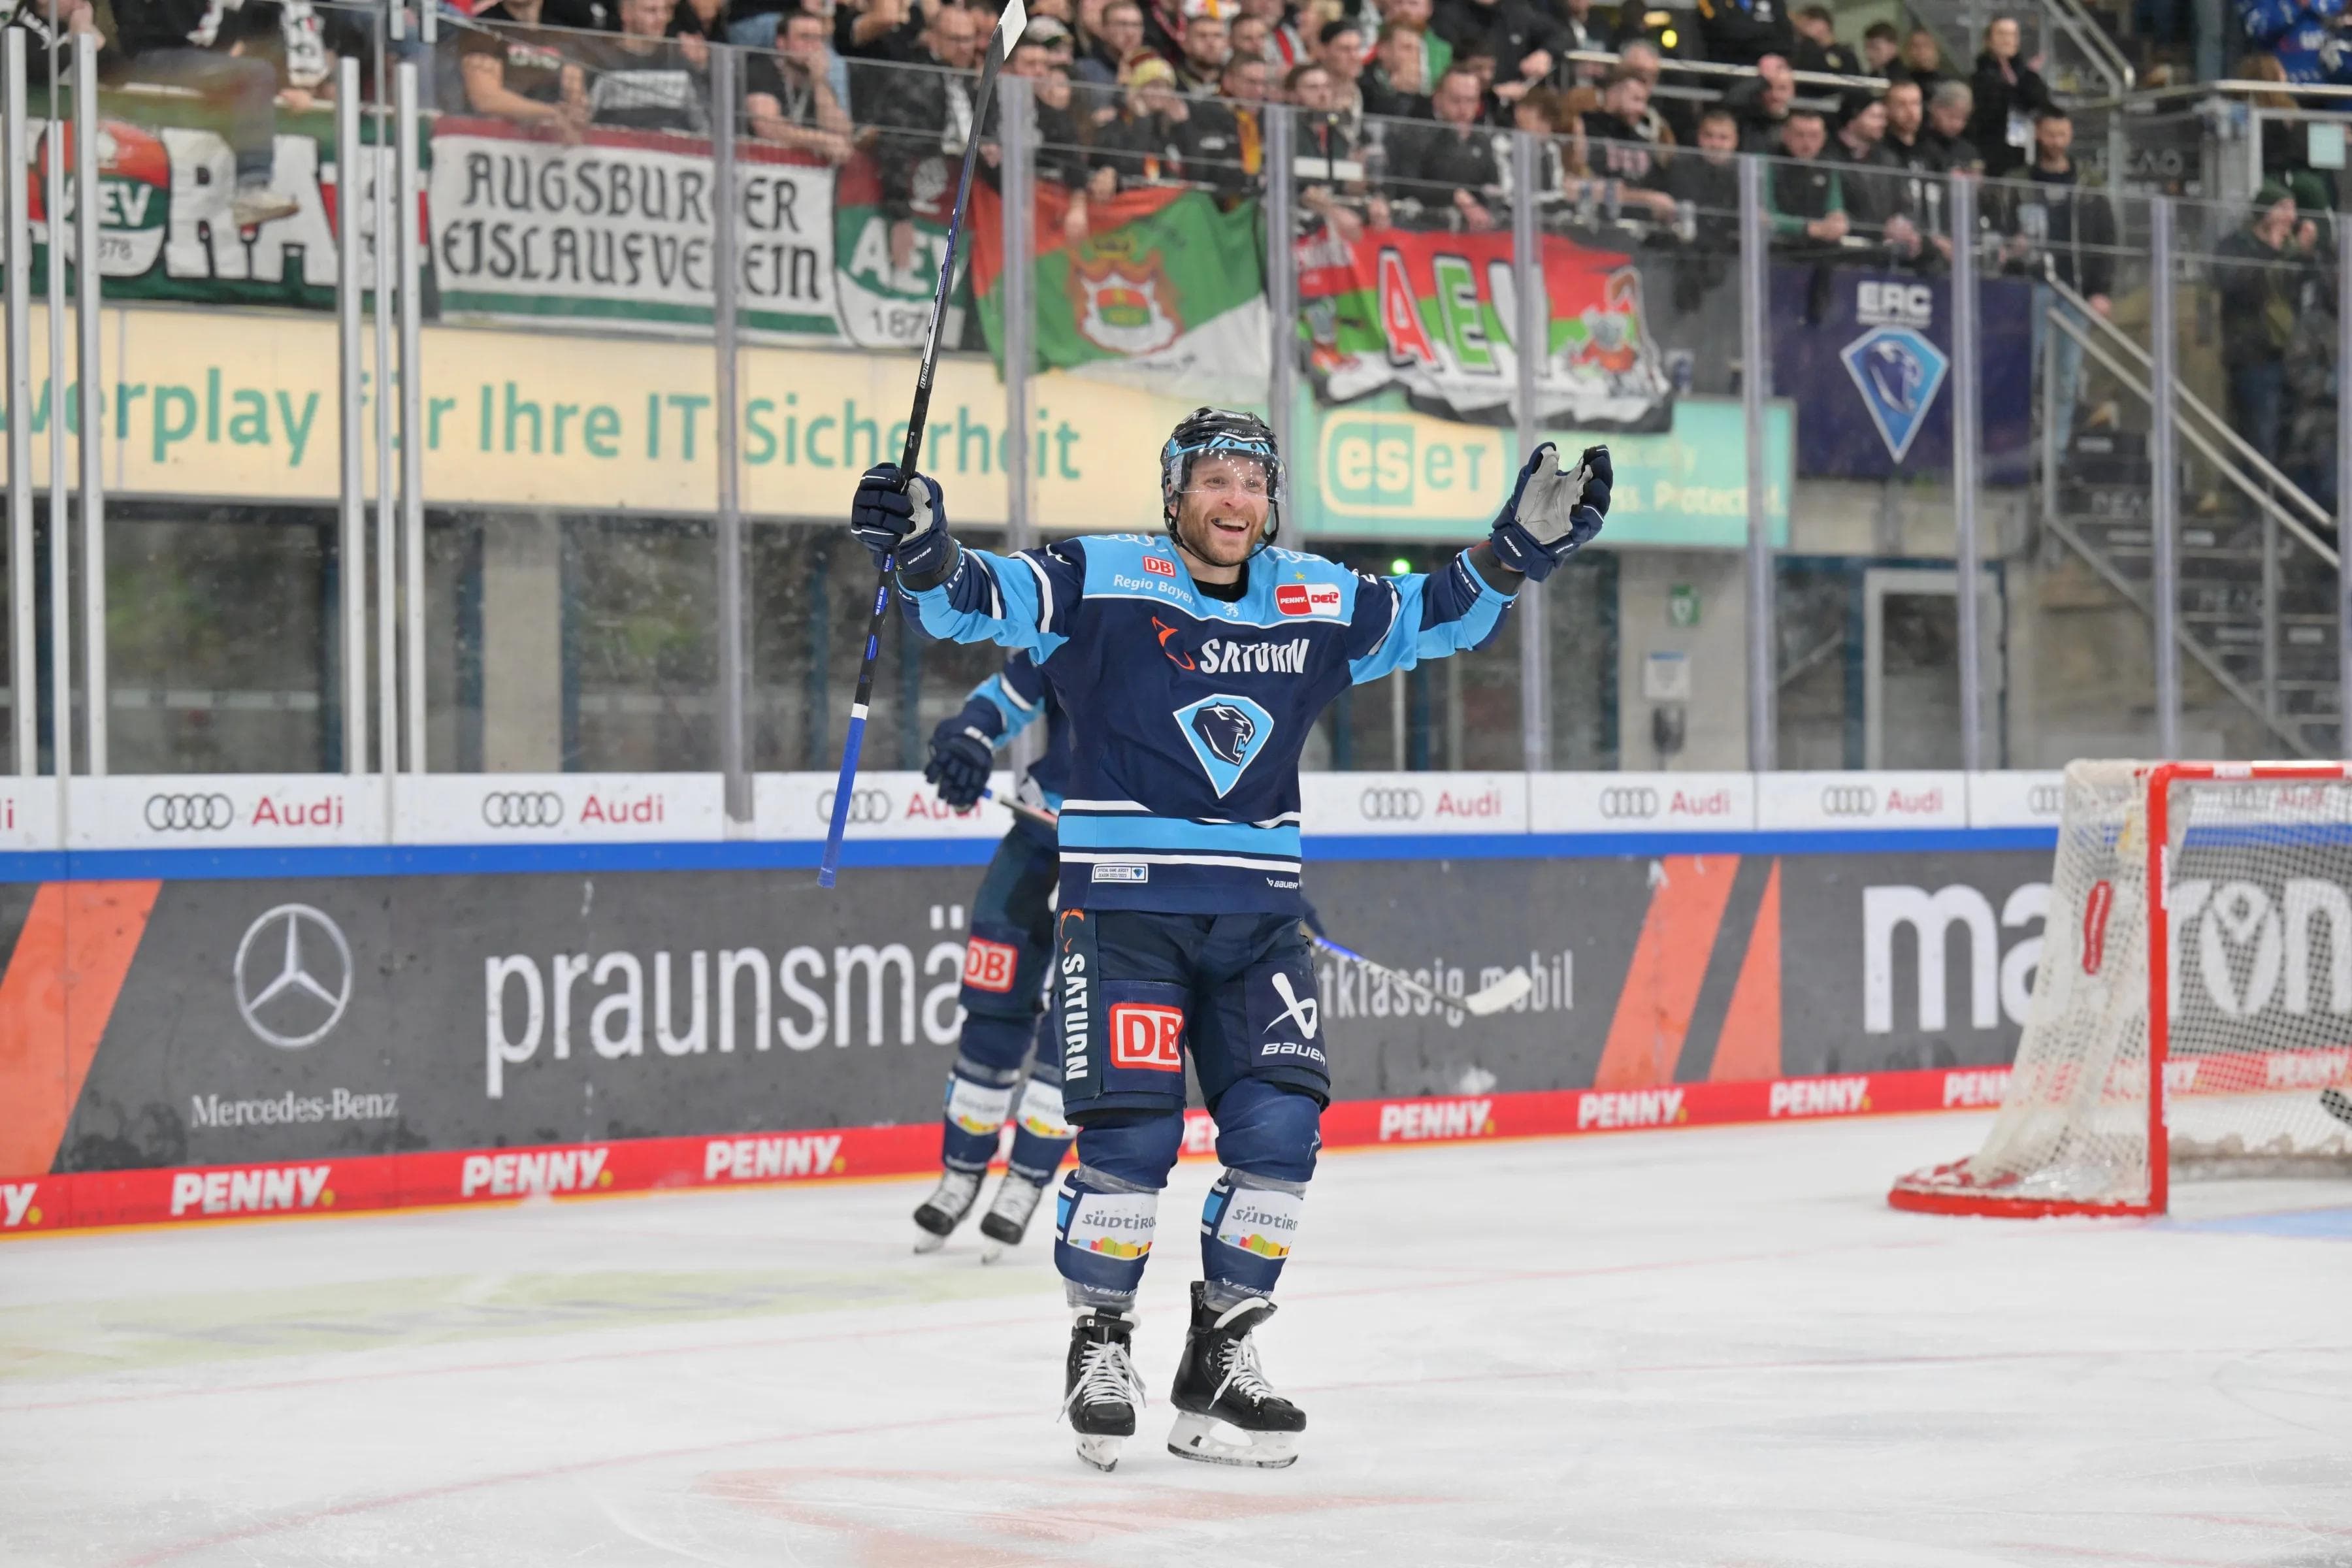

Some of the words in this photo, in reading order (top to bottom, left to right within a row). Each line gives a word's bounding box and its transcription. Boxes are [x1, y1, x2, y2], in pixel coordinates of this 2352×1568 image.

[461, 150, 801, 233] AUGSBURER
[440, 218, 822, 302] EISLAUFVEEIN
[1380, 247, 1552, 378] AEV
[1857, 280, 1933, 316] ERC
[870, 308, 930, 340] 187
[919, 363, 929, 389] AUER
[481, 382, 622, 459] Ihre
[647, 392, 710, 461] IT
[1147, 558, 1172, 574] DB
[1113, 574, 1154, 591] Regio
[1158, 581, 1195, 606] Bayer
[1311, 592, 1339, 604] DEL
[1200, 638, 1310, 674] SATURN
[252, 796, 344, 827] Audi
[580, 794, 664, 823] Audi
[906, 792, 982, 821] Aui
[1435, 791, 1502, 817] Audi
[1669, 790, 1731, 814] Audi
[1885, 788, 1944, 813] Audi
[485, 905, 966, 1098] praunsmä
[1318, 956, 1465, 1028] tklassig
[1062, 953, 1088, 1081] SATURN
[1122, 1014, 1182, 1060] DB
[192, 1088, 399, 1128] Mercedes-Benz
